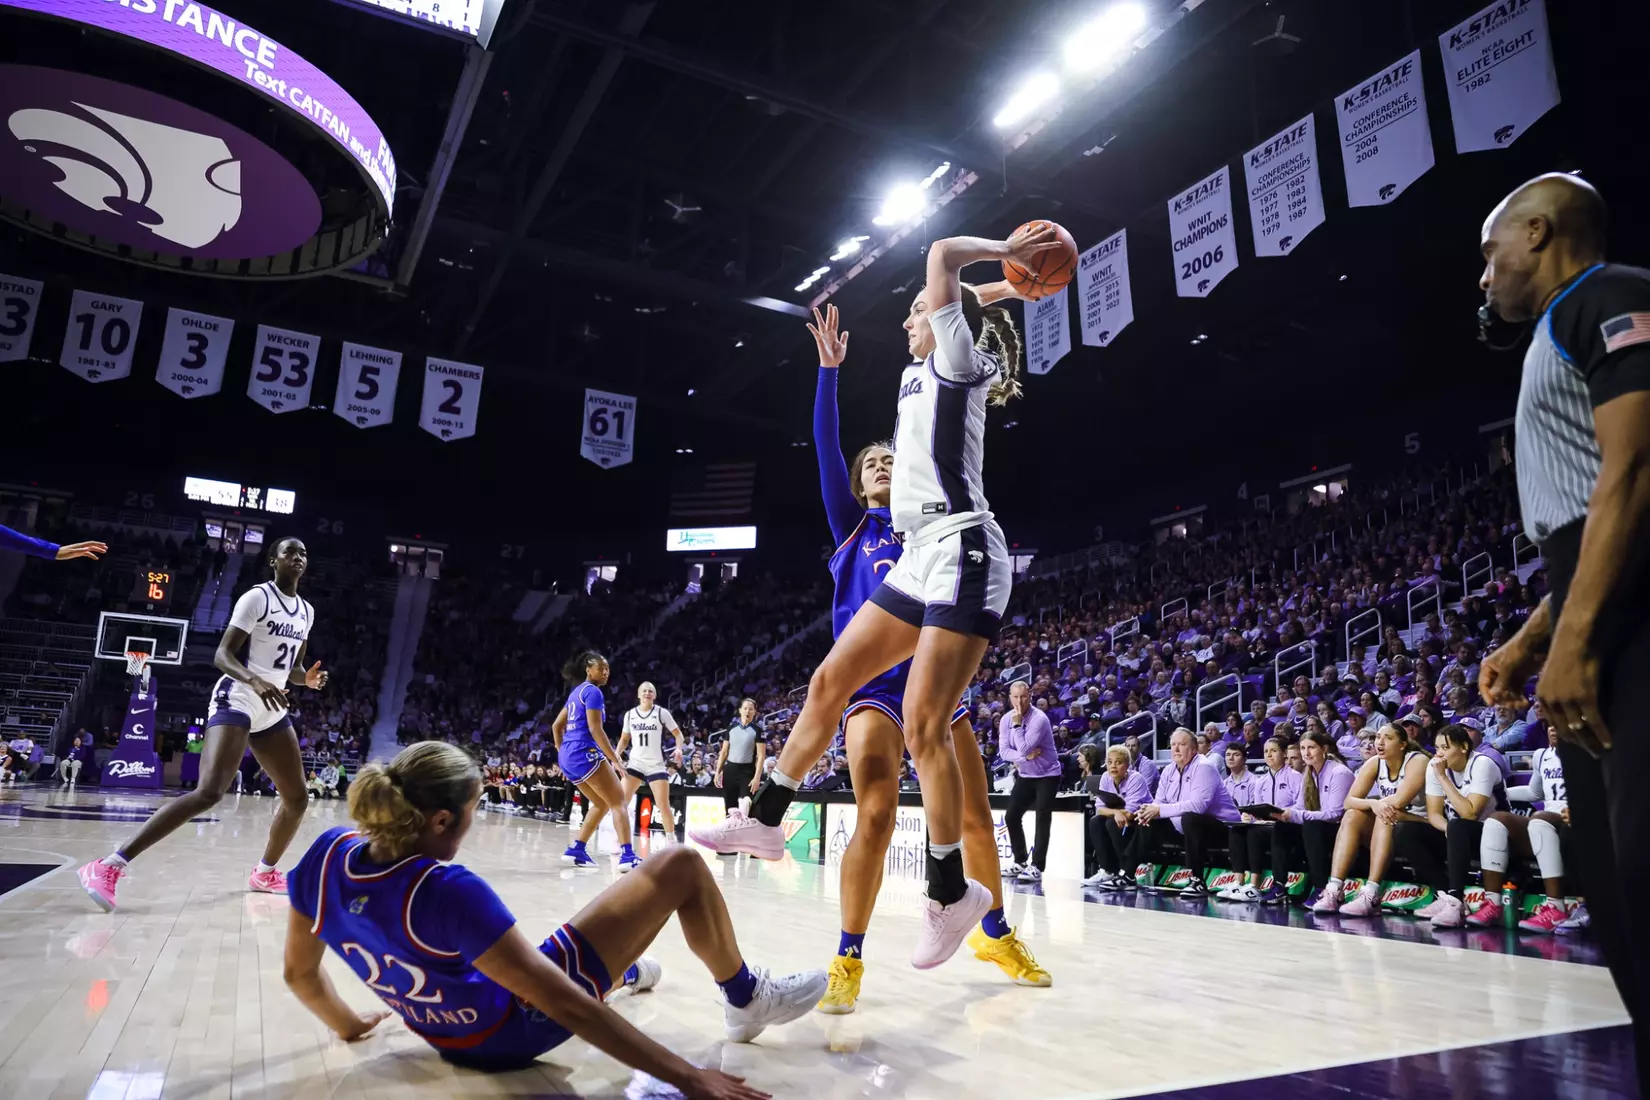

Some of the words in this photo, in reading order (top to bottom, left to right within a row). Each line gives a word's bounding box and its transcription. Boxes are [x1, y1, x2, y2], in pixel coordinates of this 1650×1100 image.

[432, 3, 440, 13] 8
[1456, 31, 1486, 52] WOMEN'S
[1486, 6, 1529, 34] BASKETBALL
[1457, 55, 1491, 81] ELITE
[1493, 29, 1534, 61] EIGHT
[1481, 38, 1505, 55] NCAA
[1344, 59, 1413, 111] K-STATE
[1465, 73, 1492, 93] 1982
[1349, 96, 1374, 114] WOMEN'S
[1374, 77, 1409, 100] BASKETBALL
[244, 59, 287, 98] Text
[289, 87, 350, 143] CATFAN
[350, 136, 372, 166] and
[1345, 96, 1418, 142] CHAMPIONSHIPS
[1353, 92, 1409, 129] CONFERENCE
[1250, 122, 1308, 167] K-STATE
[1355, 135, 1378, 153] 2004
[1356, 146, 1379, 164] 2008
[1252, 156, 1311, 196] CHAMPIONSHIPS
[1258, 152, 1304, 184] CONFERENCE
[1174, 173, 1223, 213] K-STATE
[1260, 190, 1278, 206] 1976
[1286, 175, 1305, 191] 1982
[1260, 201, 1278, 217] 1977
[1286, 185, 1306, 201] 1983
[1188, 211, 1213, 232] WNIT
[1261, 211, 1280, 227] 1978
[1287, 196, 1307, 212] 1984
[1262, 222, 1280, 237] 1979
[1288, 206, 1307, 222] 1987
[1173, 213, 1228, 253] CHAMPIONS
[1080, 235, 1122, 268] K-STATE
[1182, 244, 1224, 280] 2006
[1091, 264, 1113, 283] WNIT
[0, 282, 35, 296] STAD
[1105, 282, 1120, 293] 2015
[1105, 290, 1120, 302] 2018
[0, 297, 30, 336] 3
[91, 300, 123, 313] GARY
[1036, 297, 1056, 315] AIAW
[1086, 308, 1101, 320] 2007
[76, 313, 131, 356] 10
[181, 317, 219, 332] OHLDE
[180, 332, 209, 370] 3
[267, 333, 310, 349] WECKER
[77, 356, 116, 369] 1981-83
[256, 345, 310, 388] 53
[350, 349, 393, 365] LEHNING
[171, 373, 208, 386] 2000-04
[428, 364, 480, 380] CHAMBERS
[354, 365, 380, 401] 5
[899, 376, 924, 401] ats
[261, 388, 297, 401] 2001-05
[438, 379, 463, 415] 2
[347, 404, 381, 416] 2005-09
[590, 407, 625, 440] 61
[1404, 432, 1421, 454] 5
[1236, 482, 1249, 500] 4
[316, 517, 345, 535] 26
[500, 544, 525, 559] 27
[148, 572, 169, 583] 5:27
[148, 583, 164, 599] 16
[266, 620, 305, 641] Wildcat
[273, 642, 297, 670] 21
[631, 723, 658, 732] Wildcats
[639, 732, 649, 747] 11
[108, 760, 155, 776] Dillons
[1382, 886, 1425, 903] LIBMAN
[341, 942, 443, 1004] 22
